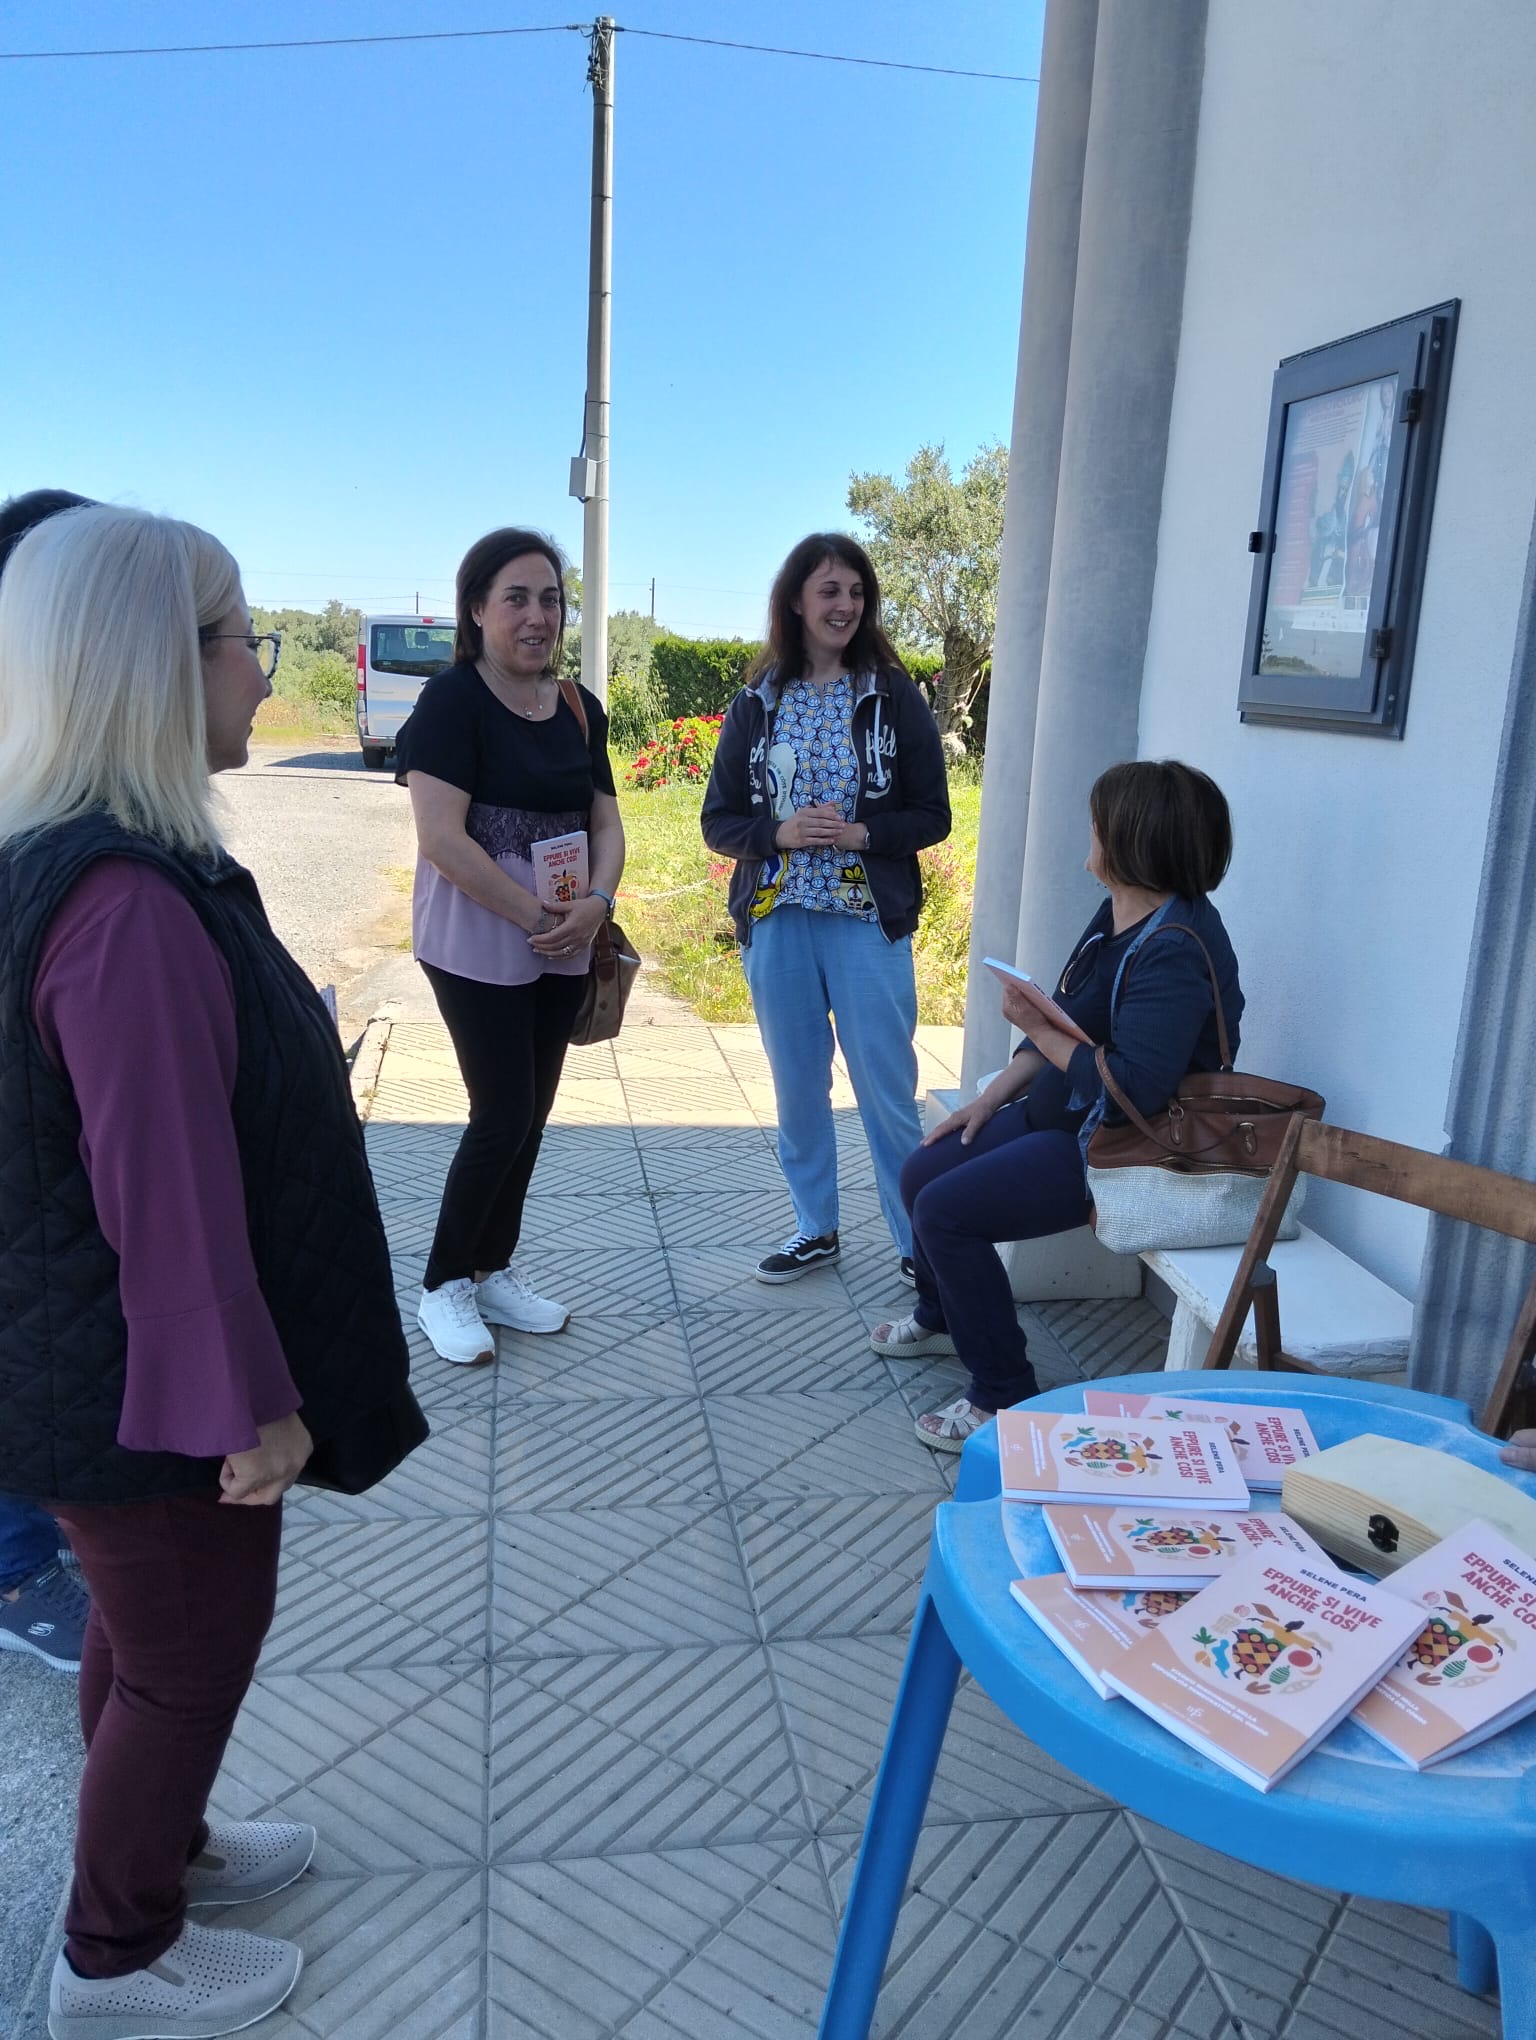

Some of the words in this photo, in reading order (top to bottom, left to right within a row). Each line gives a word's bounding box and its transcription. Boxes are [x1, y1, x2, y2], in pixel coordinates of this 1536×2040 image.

[1254, 1421, 1275, 1446] ANCHE
[1267, 1416, 1289, 1443] EPPURE
[1168, 1436, 1188, 1460] ANCHE
[1182, 1430, 1203, 1457] EPPURE
[1190, 1458, 1206, 1466] SI
[1194, 1467, 1212, 1484] VIVE
[1247, 1518, 1277, 1538] EPPURE
[1300, 1568, 1338, 1590] SELENE
[1339, 1586, 1367, 1602] PERA
[1463, 1552, 1521, 1595] EPPURE
[1262, 1567, 1322, 1601] EPPURE
[1321, 1595, 1341, 1610] SI
[1342, 1603, 1382, 1629] VIVE
[1264, 1583, 1320, 1614] ANCHE
[1461, 1570, 1515, 1609] ANCHE
